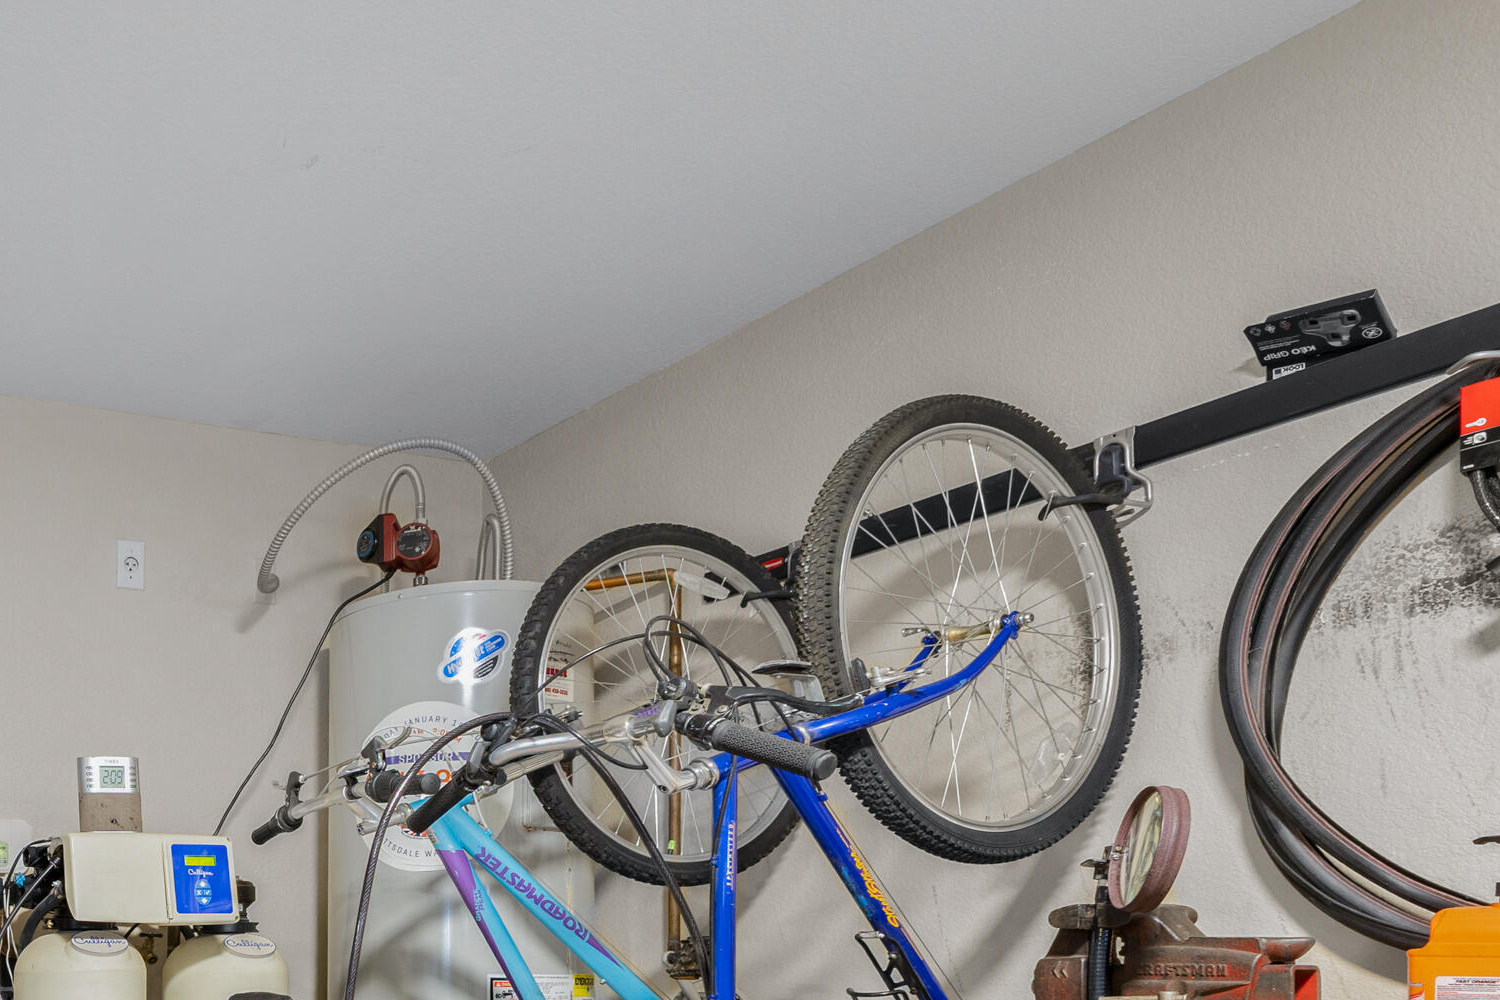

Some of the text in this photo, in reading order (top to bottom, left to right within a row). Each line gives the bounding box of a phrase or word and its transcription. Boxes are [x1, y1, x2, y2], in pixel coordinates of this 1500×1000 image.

[1263, 351, 1290, 361] GRIP
[1282, 363, 1305, 372] LOOK
[398, 751, 454, 764] SPOSOR
[382, 837, 420, 857] TTSDALE
[187, 868, 215, 878] Culligan
[475, 846, 589, 941] ROADMASTER
[74, 936, 127, 948] Culligan
[226, 939, 274, 950] Culligan
